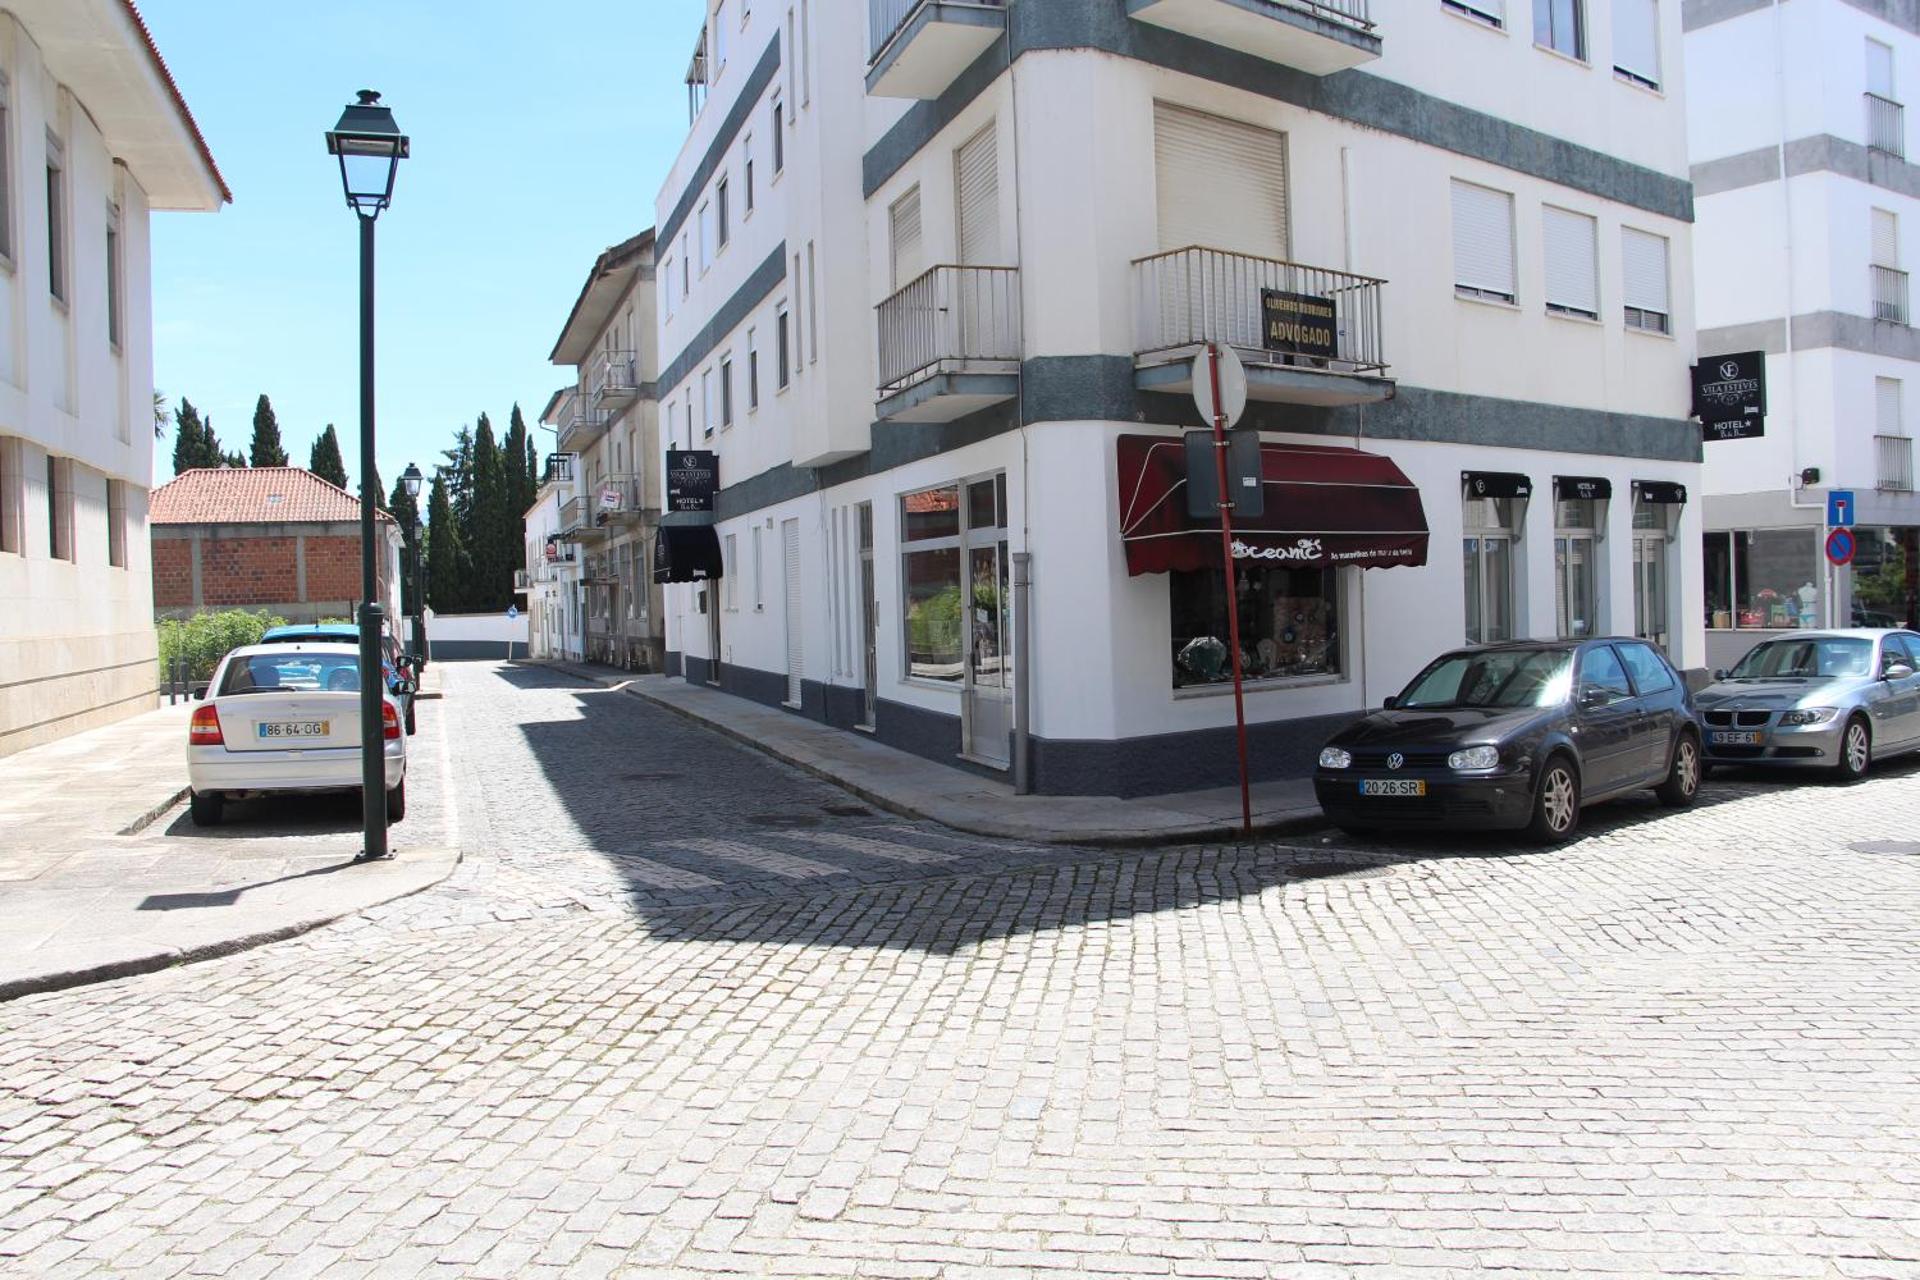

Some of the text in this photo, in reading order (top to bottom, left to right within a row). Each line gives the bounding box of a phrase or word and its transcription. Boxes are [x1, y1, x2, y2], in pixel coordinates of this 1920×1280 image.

[1270, 320, 1331, 347] ADVOGADO
[1703, 384, 1723, 394] VILA
[1714, 420, 1744, 431] HOTEL
